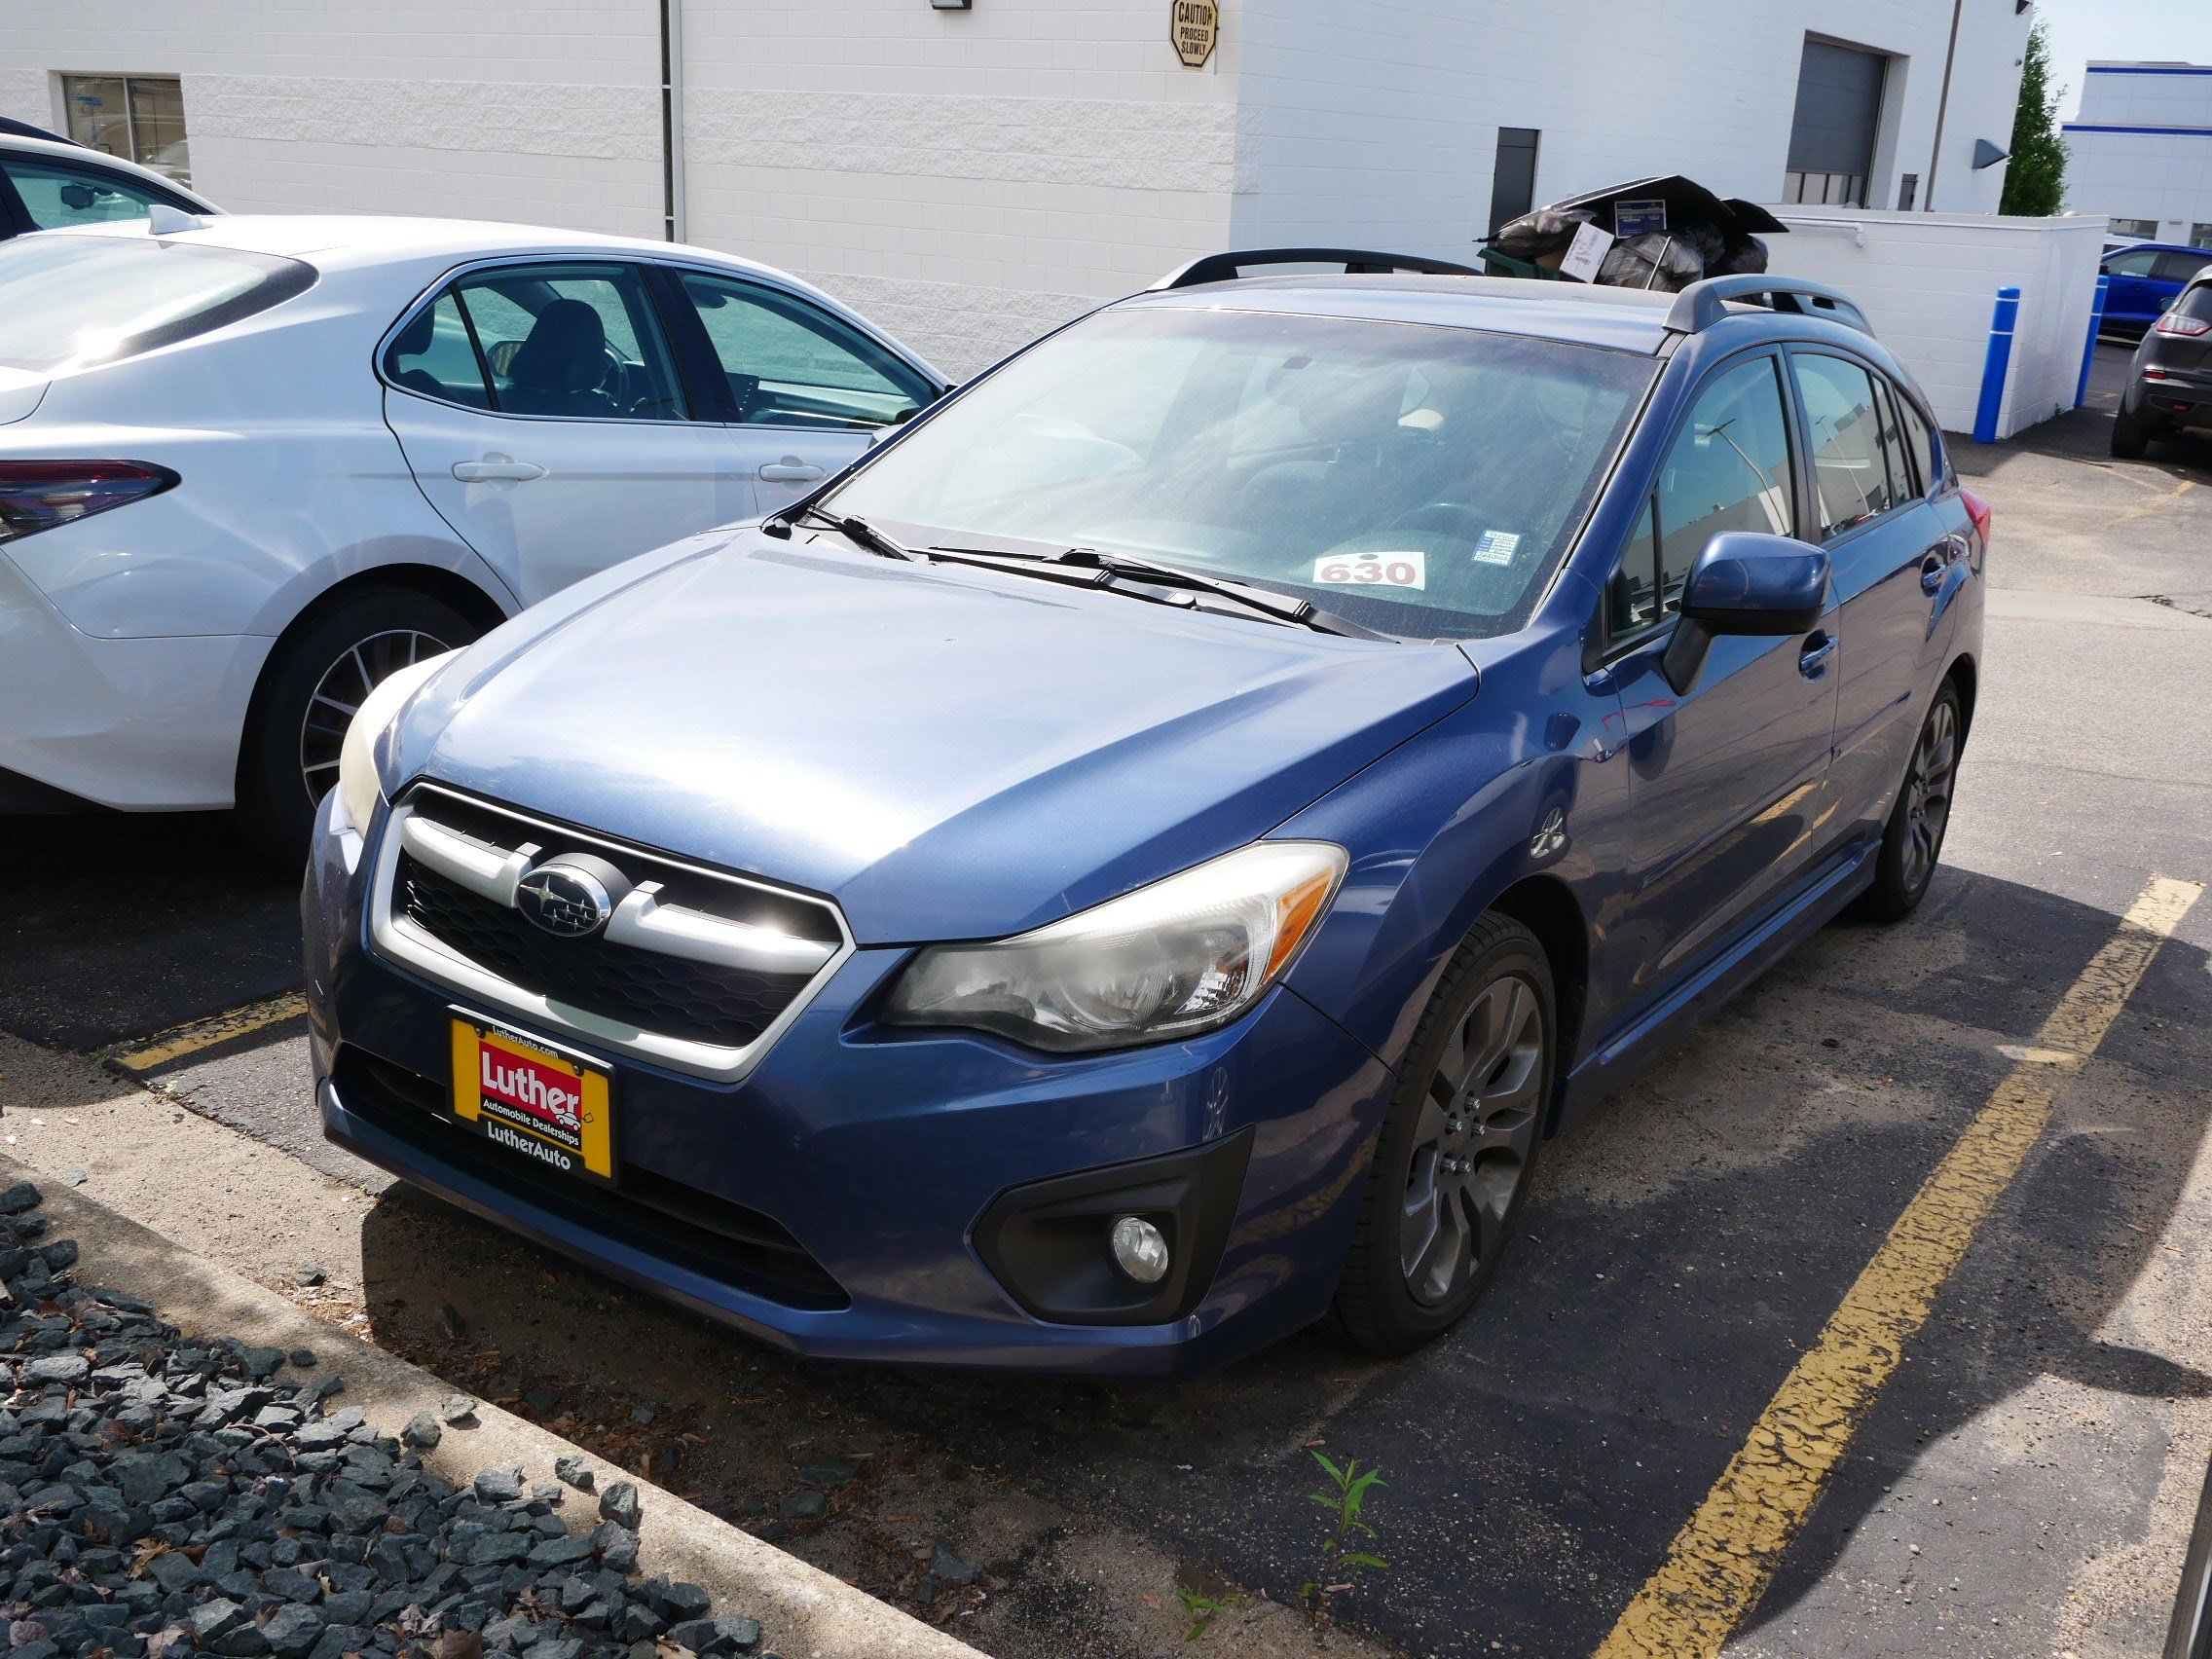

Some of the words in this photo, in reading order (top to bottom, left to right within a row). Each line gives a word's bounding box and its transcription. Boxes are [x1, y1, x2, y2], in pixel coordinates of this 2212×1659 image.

[1178, 2, 1212, 26] CAUTION
[1180, 27, 1208, 42] PROCEED
[1181, 41, 1206, 55] SLOWLY
[1321, 563, 1416, 585] 630
[492, 1025, 559, 1059] LutherAuto.com
[482, 1051, 579, 1116] Luther
[483, 1098, 532, 1125] Automobile
[533, 1118, 579, 1147] Dealerships
[488, 1121, 571, 1170] LutherAuto
